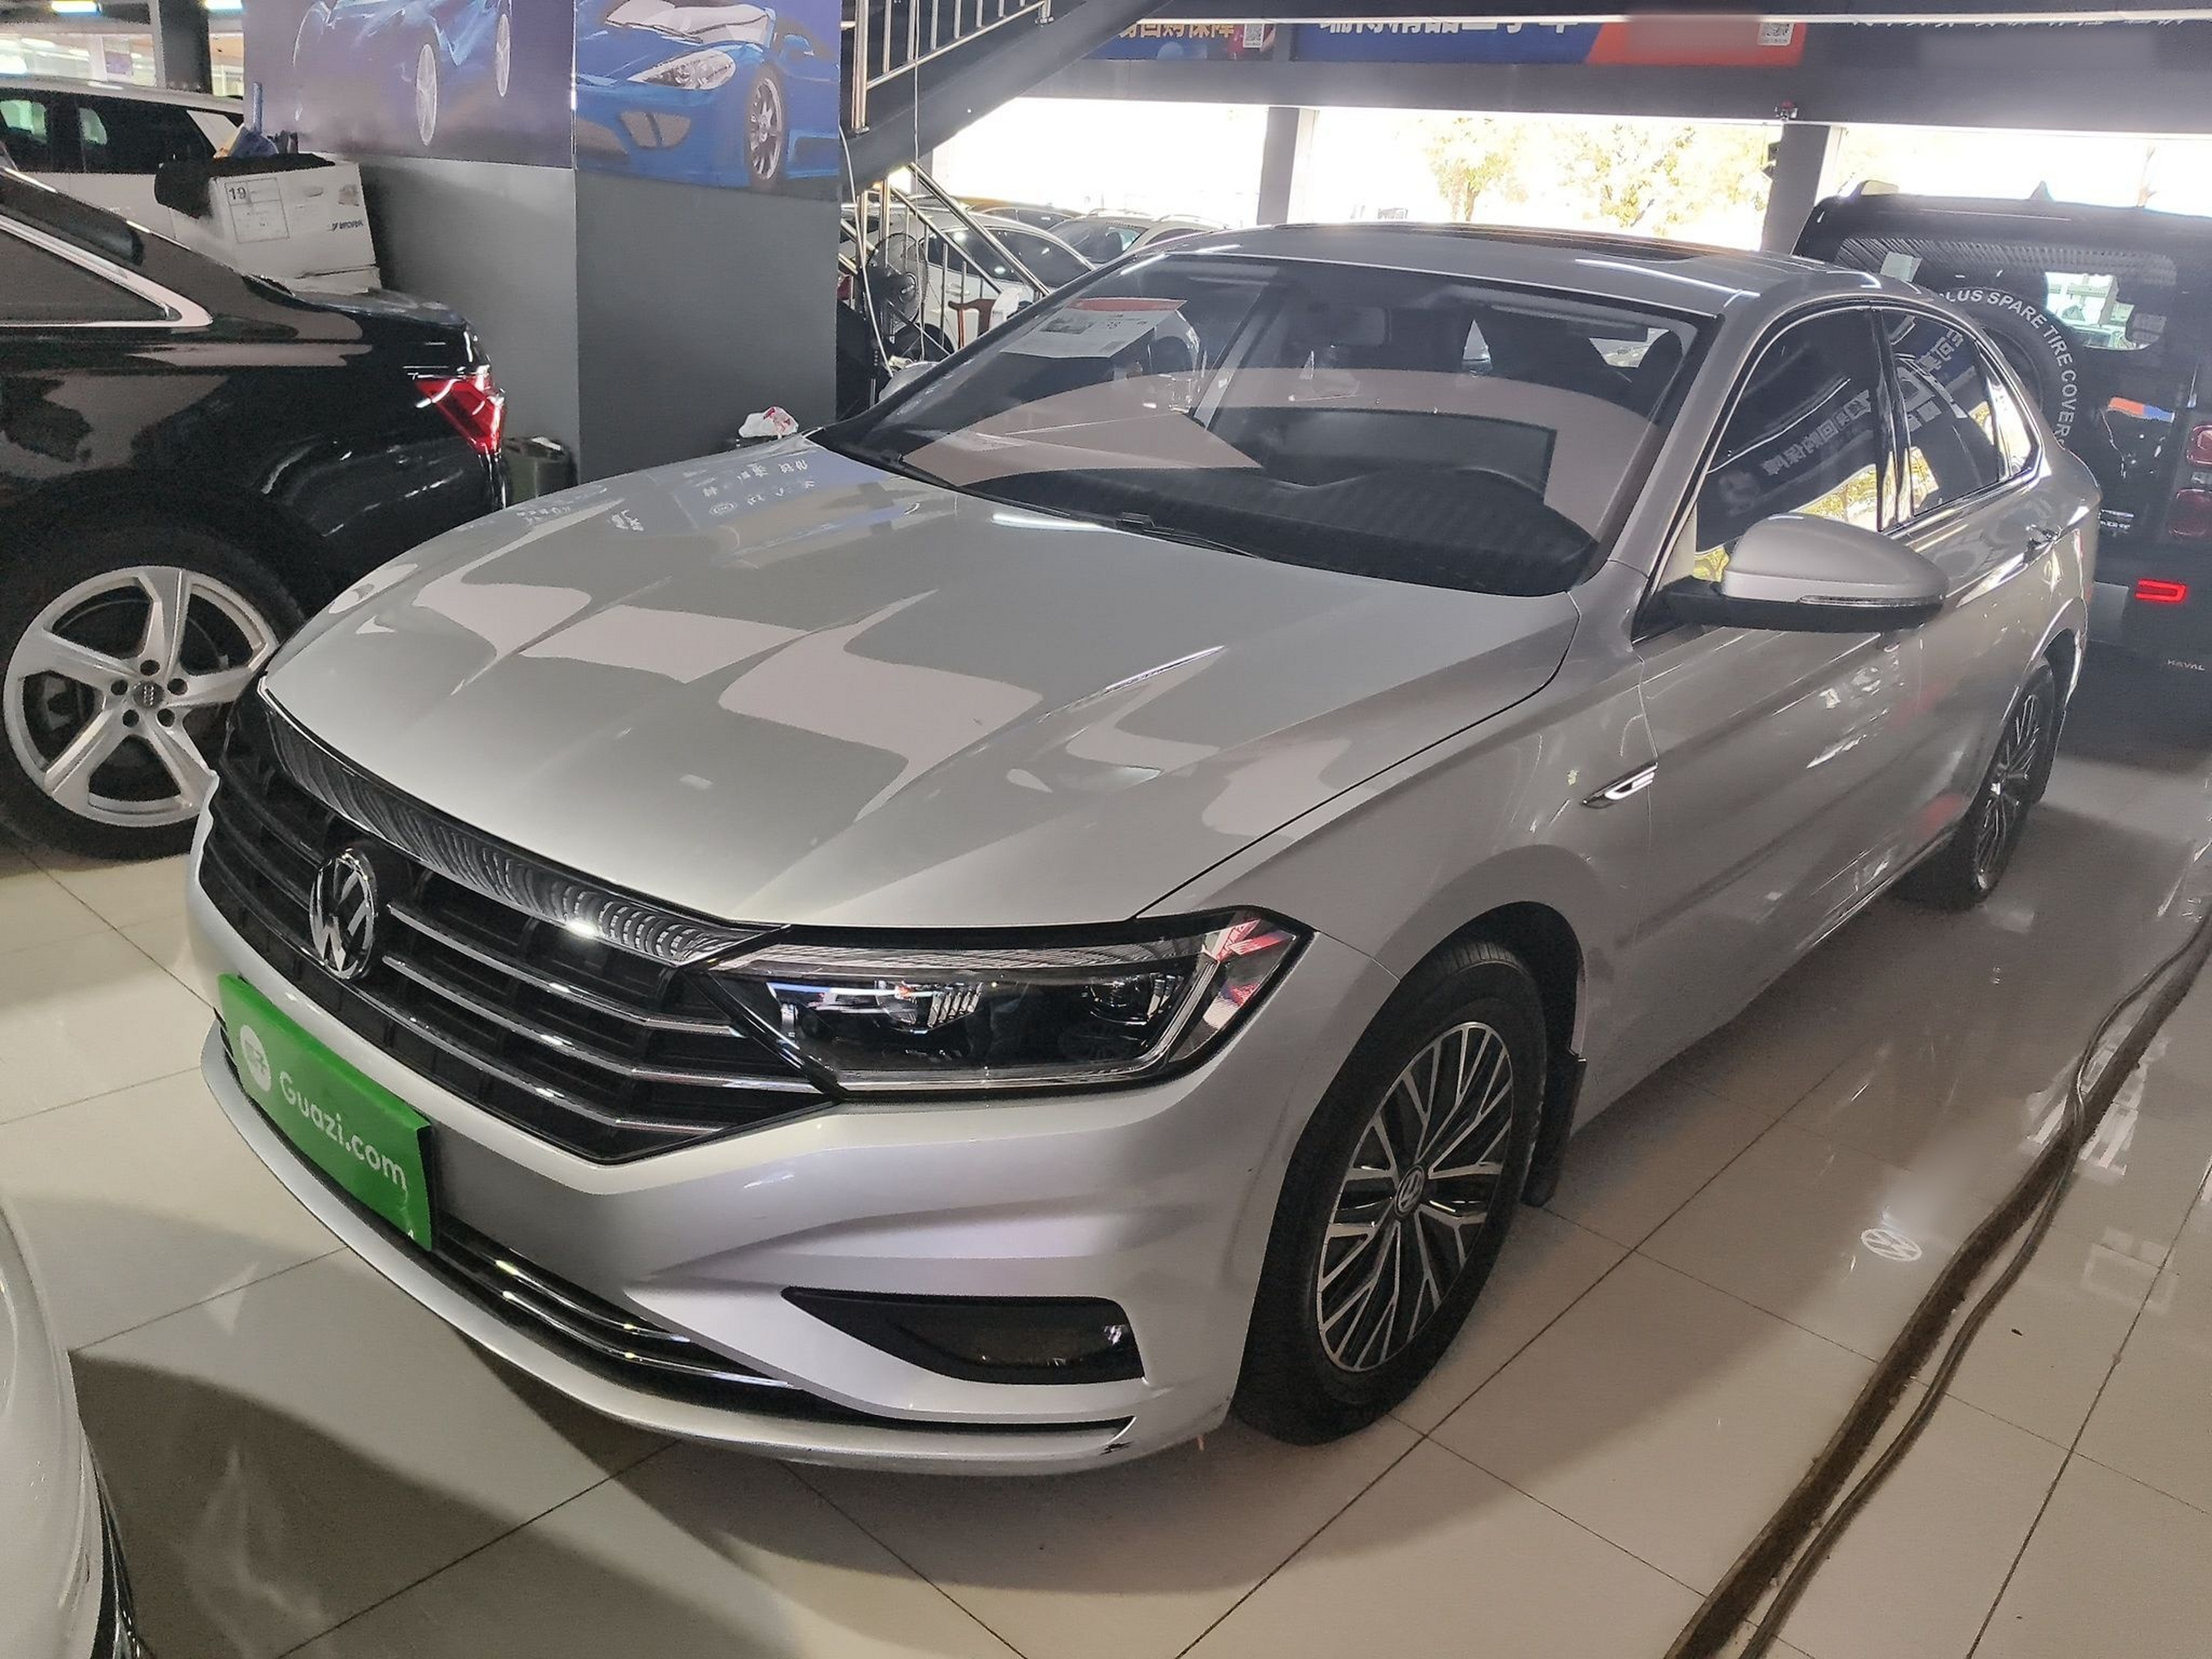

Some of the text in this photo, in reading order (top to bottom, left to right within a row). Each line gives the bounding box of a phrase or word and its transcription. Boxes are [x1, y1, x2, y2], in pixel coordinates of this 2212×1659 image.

[1940, 290, 2078, 440] LUS SPARE TIRE COVER
[2168, 660, 2205, 671] HAVAL
[280, 1071, 408, 1191] Guazi.com
